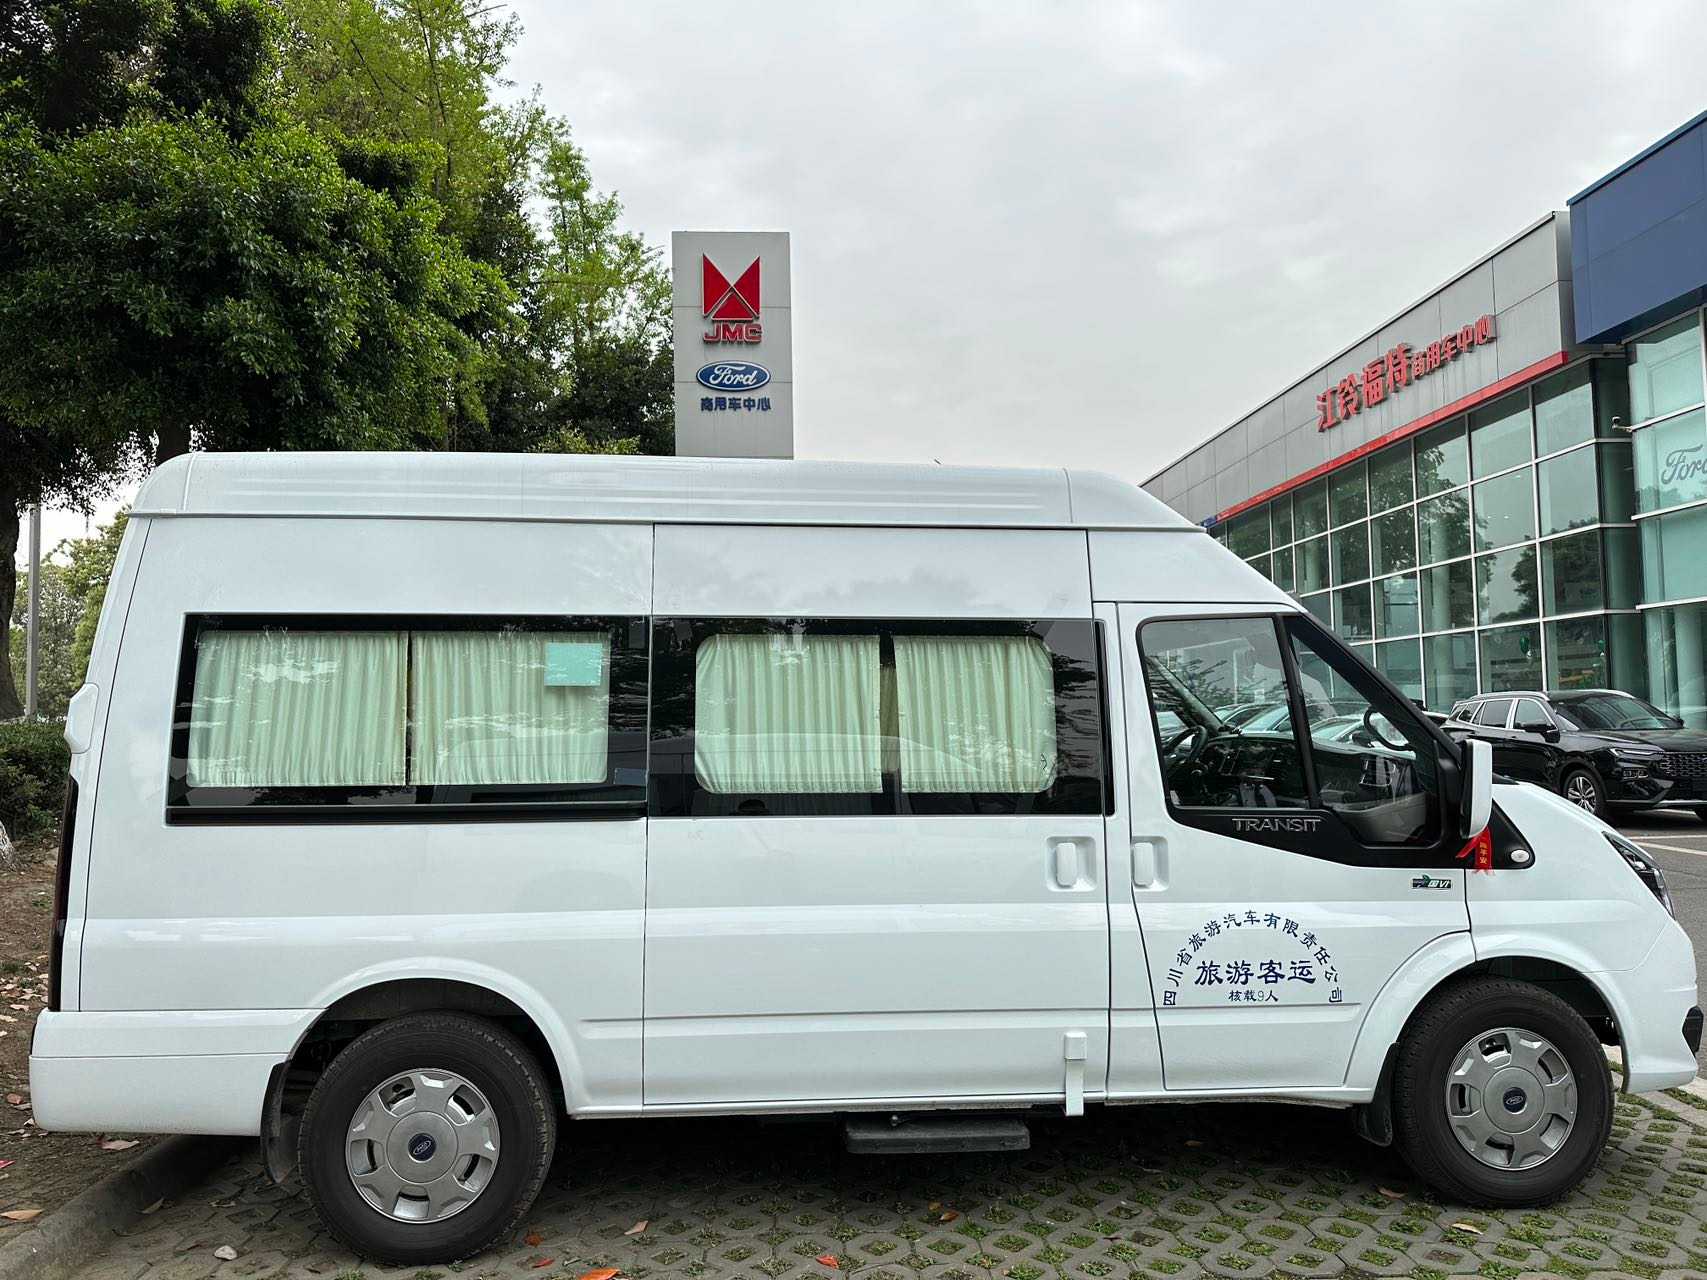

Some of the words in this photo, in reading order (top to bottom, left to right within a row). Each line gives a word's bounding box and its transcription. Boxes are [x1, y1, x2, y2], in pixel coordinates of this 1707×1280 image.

[703, 322, 763, 344] JMC
[708, 363, 758, 386] Ford
[700, 396, 772, 412] 商用车中心
[1231, 818, 1321, 832] TRANSIT
[1163, 910, 1343, 1006] 四川省旅游汽车有限责任公司
[1194, 959, 1317, 986] 旅游客运
[1228, 989, 1280, 1003] 核载9人
